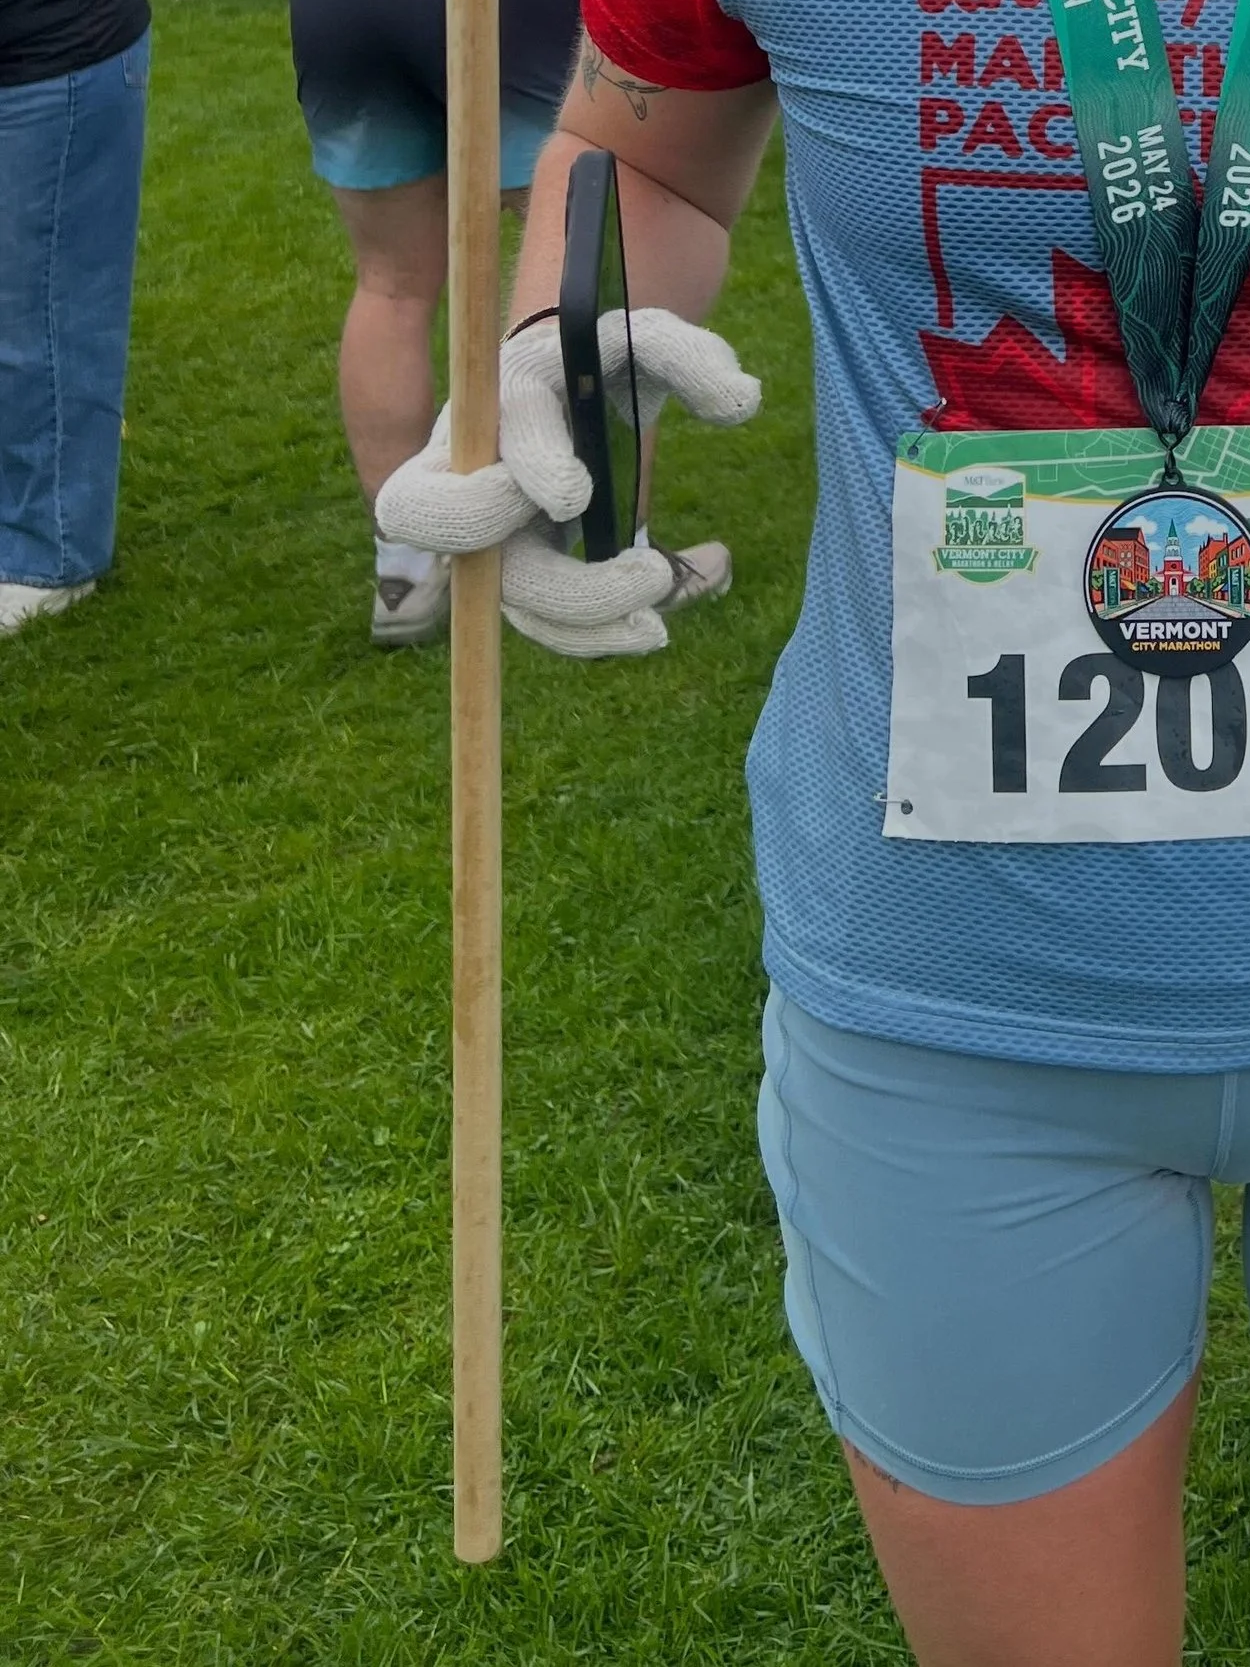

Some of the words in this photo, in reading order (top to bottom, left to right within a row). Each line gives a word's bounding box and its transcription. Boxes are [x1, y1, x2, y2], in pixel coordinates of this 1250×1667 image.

[919, 96, 1075, 160] PAC
[1137, 124, 1171, 175] MAY
[1097, 135, 1147, 225] 2026
[1148, 180, 1178, 212] 24
[941, 549, 997, 560] VERMONT
[998, 549, 1026, 560] CITY
[1119, 621, 1232, 640] VERMONT
[1131, 642, 1156, 652] CITY
[1159, 640, 1221, 651] MARATHON
